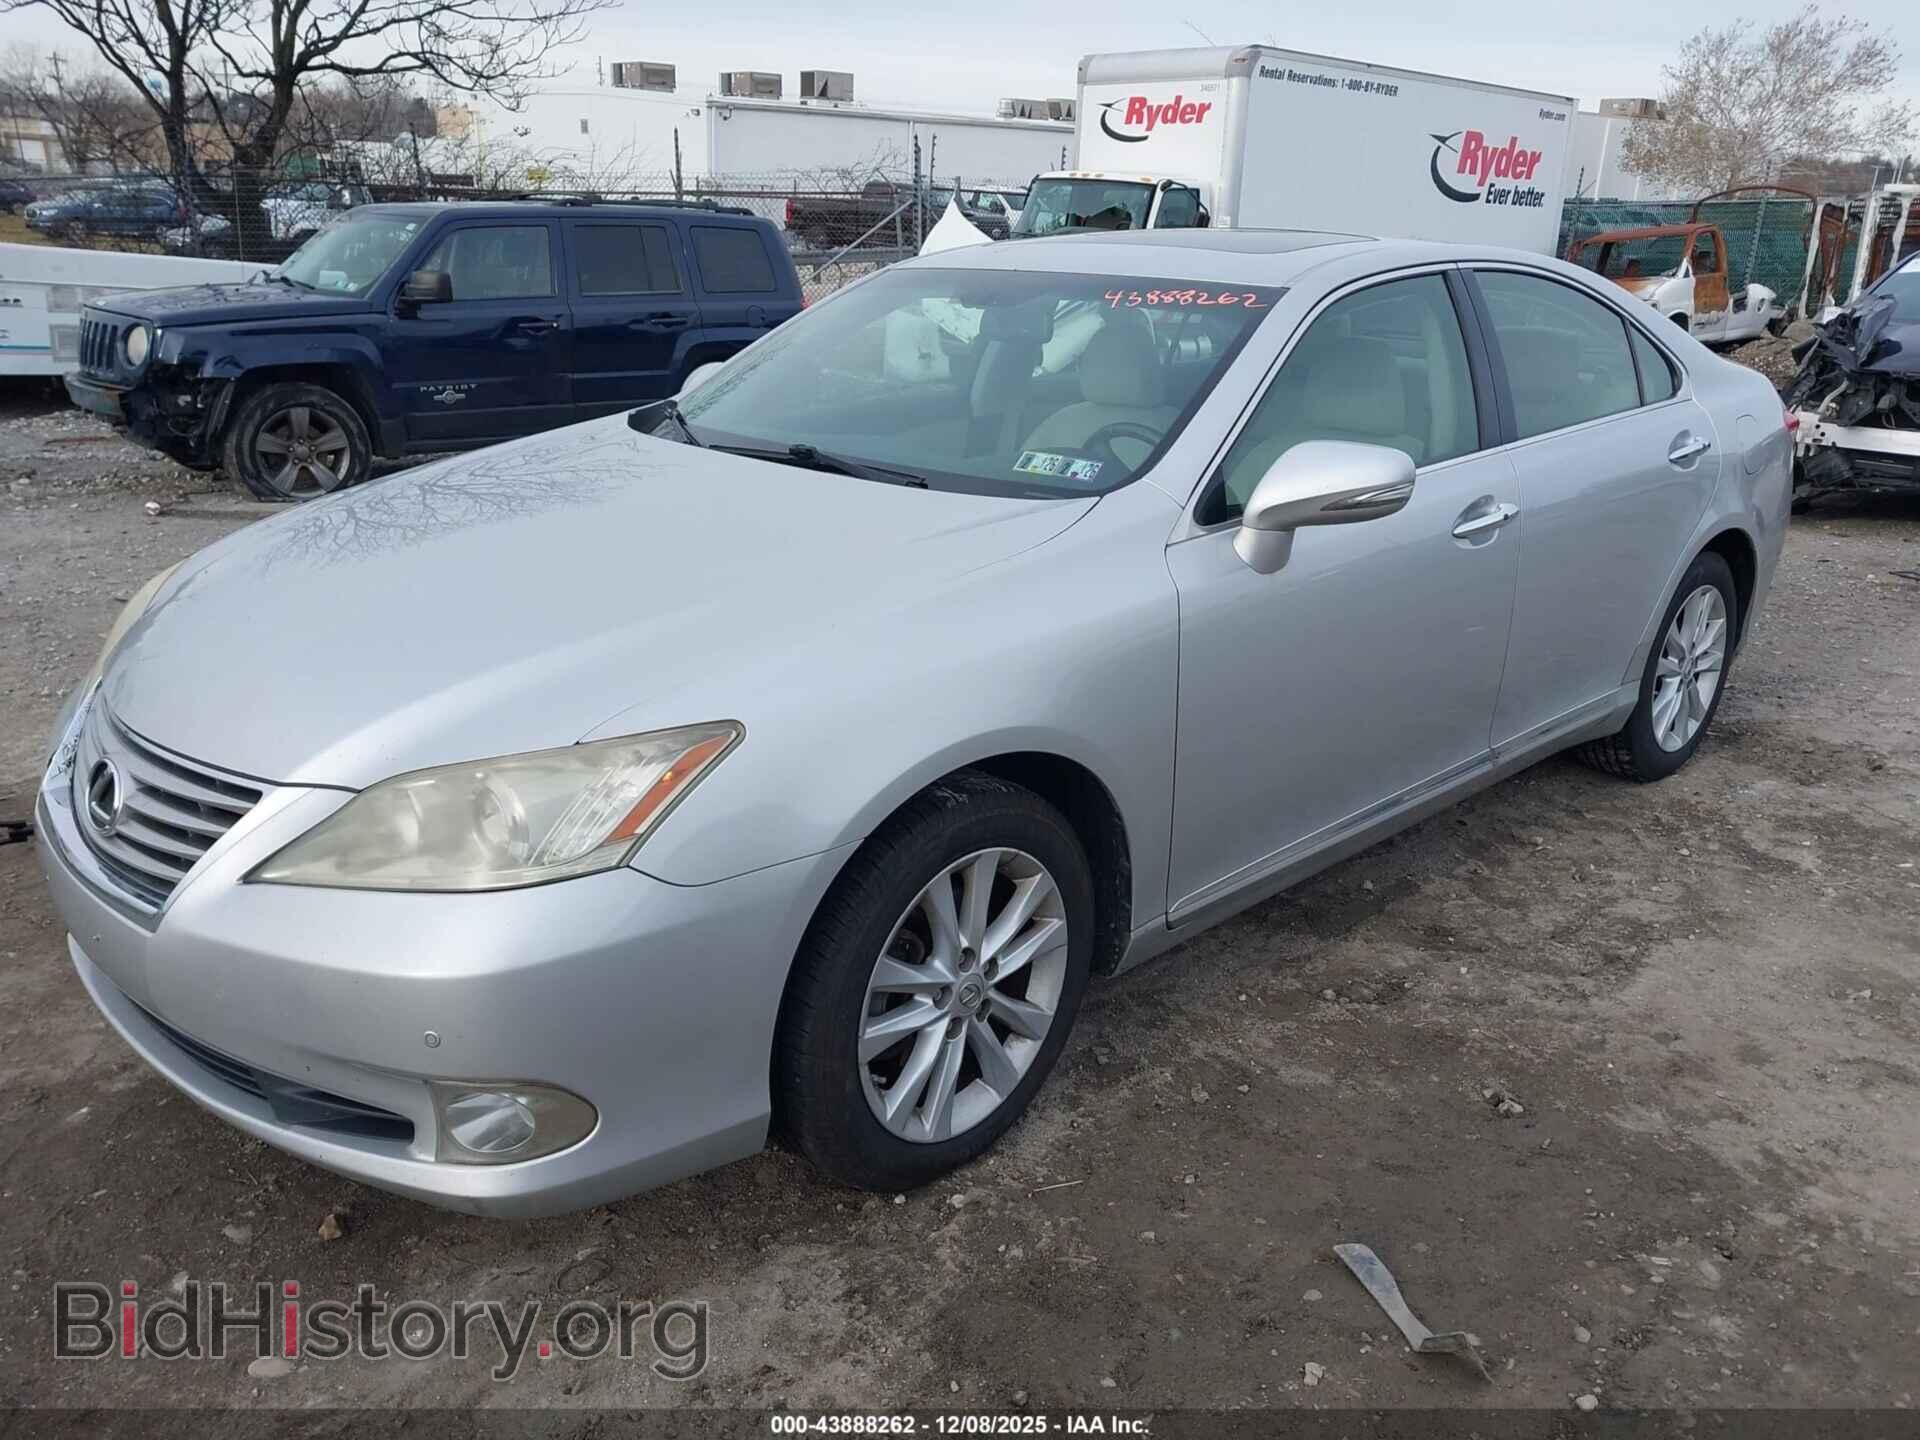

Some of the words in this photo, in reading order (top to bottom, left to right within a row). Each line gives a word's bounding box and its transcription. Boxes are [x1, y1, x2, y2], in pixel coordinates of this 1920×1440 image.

[1259, 65, 1286, 80] Rental
[1287, 69, 1339, 88] Reservations:
[1340, 78, 1399, 97] 1-800-BY-RYDER
[1124, 95, 1213, 132] Ryder
[1539, 108, 1567, 121] Ryder.com
[1456, 130, 1542, 187] Ryder
[1485, 182, 1512, 206] Ever
[1104, 288, 1268, 309] 43888262
